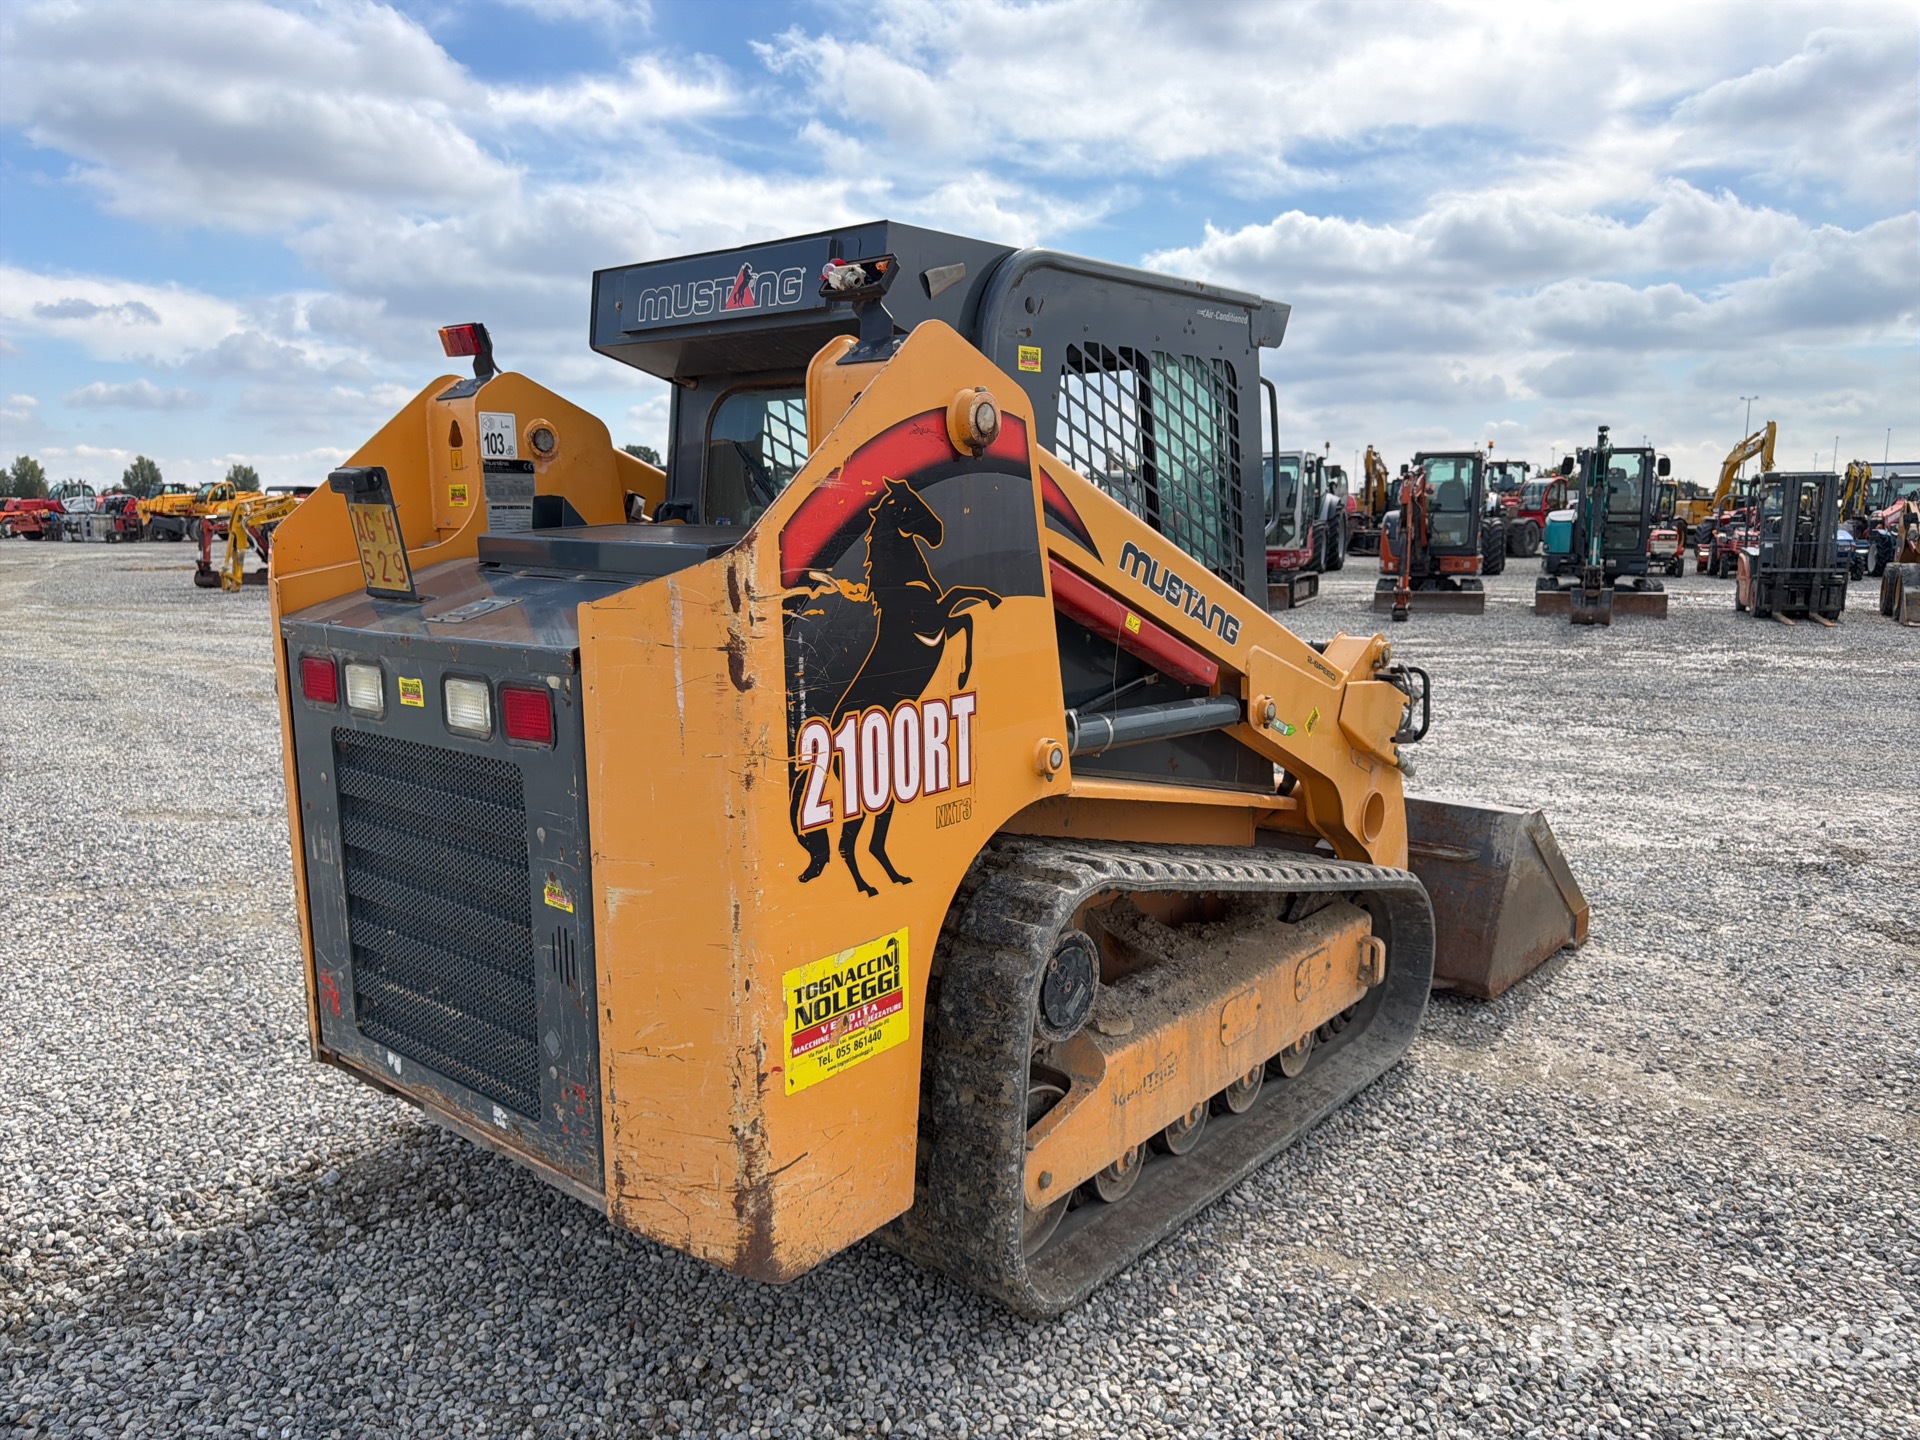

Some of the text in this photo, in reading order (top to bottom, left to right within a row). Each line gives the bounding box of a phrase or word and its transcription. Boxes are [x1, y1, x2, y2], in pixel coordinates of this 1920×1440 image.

[638, 264, 804, 323] MUSTANG
[484, 432, 505, 455] 103
[362, 548, 406, 583] 529
[1118, 540, 1241, 647] MUSTANG
[798, 691, 976, 830] 2100RT
[936, 797, 972, 829] NXT3
[794, 940, 900, 1005] TOGNACCINI
[795, 965, 901, 1030] NOLEGGI
[820, 1004, 878, 1034] VEDITA
[793, 1035, 830, 1056] MACCHINE
[817, 1052, 833, 1067] Tel.
[836, 1043, 851, 1059] 055
[853, 1029, 882, 1051] 861440
